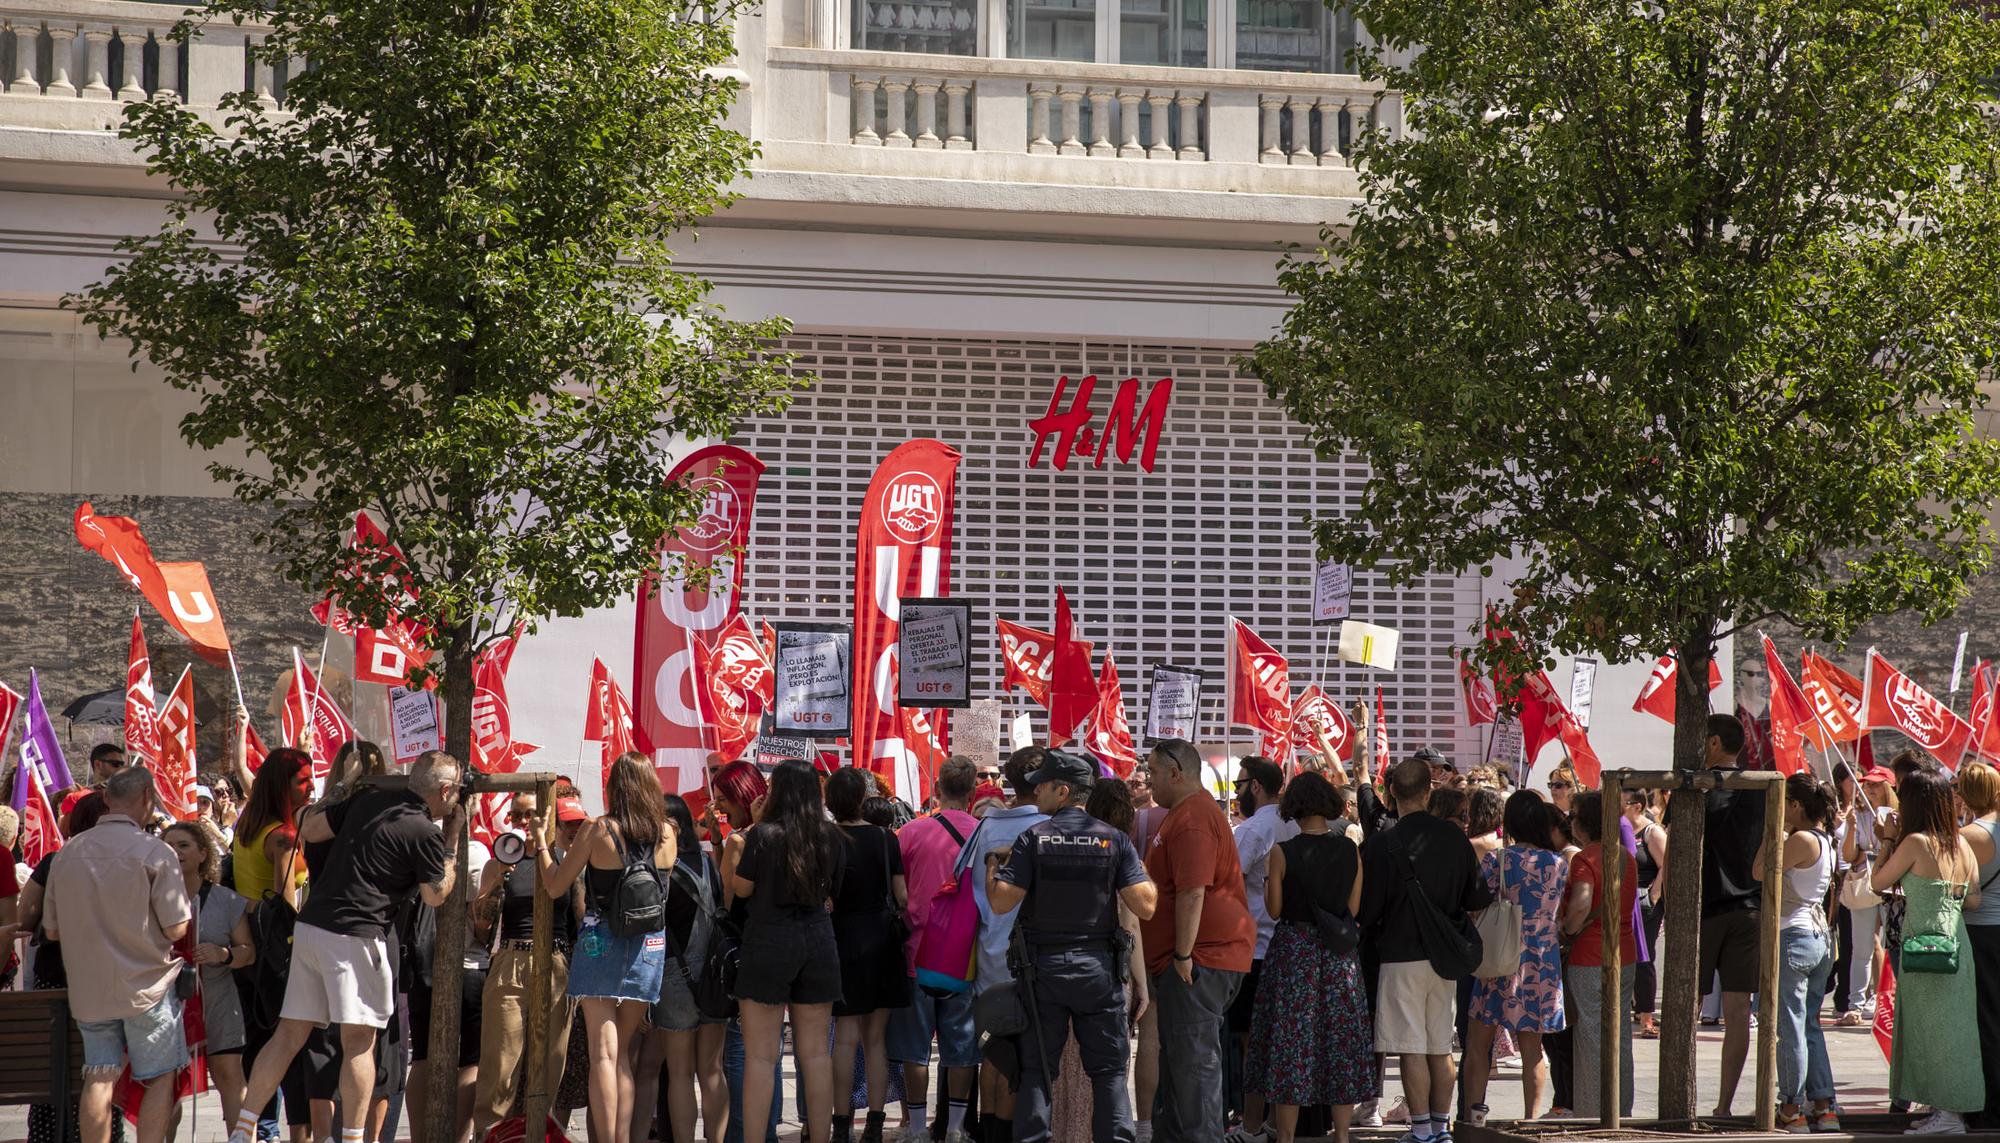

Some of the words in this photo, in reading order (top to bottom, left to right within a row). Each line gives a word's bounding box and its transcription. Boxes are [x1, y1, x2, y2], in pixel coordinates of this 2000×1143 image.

[1028, 375, 1173, 473] H&M
[890, 484, 935, 512] UGT
[907, 626, 936, 637] REBAJAS
[936, 624, 945, 632] DE
[910, 640, 935, 651] OFERTA
[911, 650, 919, 658] EL
[919, 644, 949, 656] TRABAJO
[949, 642, 959, 650] DE
[918, 655, 928, 663] LO
[927, 653, 946, 662] HACE
[809, 669, 819, 677] ES
[916, 682, 941, 693] UGT
[793, 711, 820, 723] UGT
[1158, 726, 1176, 735] UGT
[1901, 717, 1931, 744] Madrid
[405, 741, 420, 753] UGT
[760, 735, 806, 749] NUESTROS
[758, 744, 805, 758] DERECHOS
[1038, 835, 1101, 847] POLICIA
